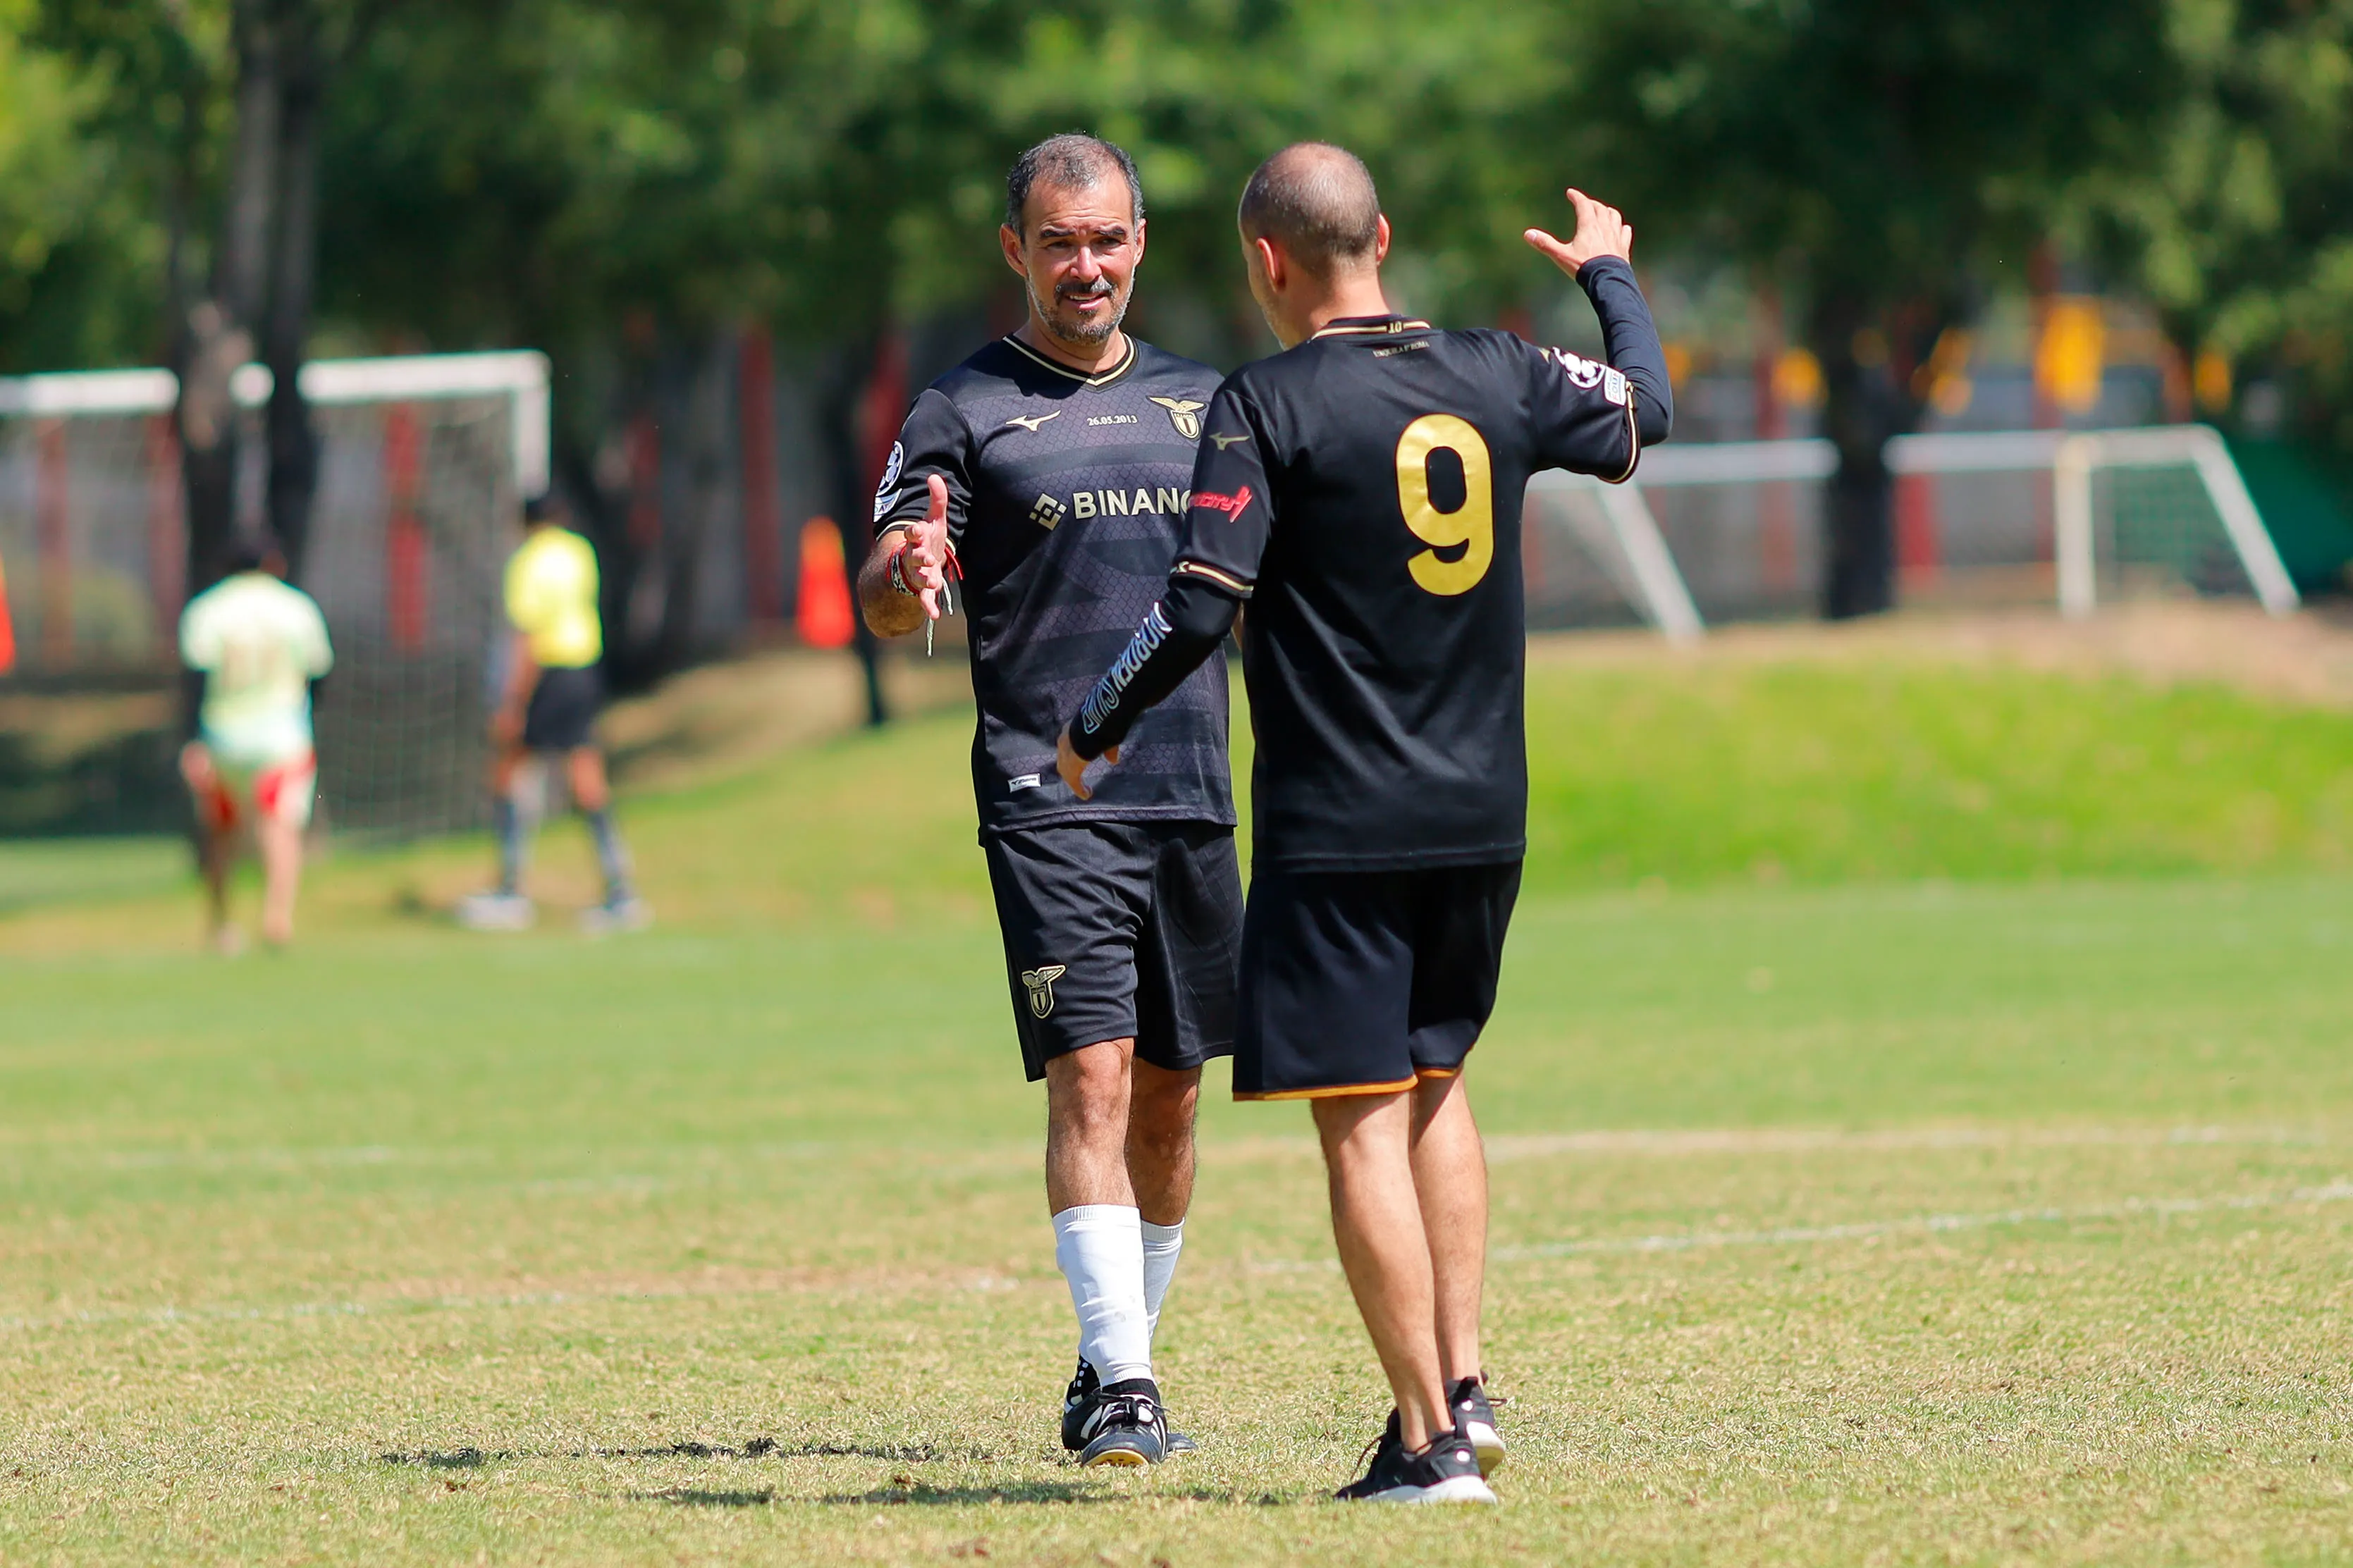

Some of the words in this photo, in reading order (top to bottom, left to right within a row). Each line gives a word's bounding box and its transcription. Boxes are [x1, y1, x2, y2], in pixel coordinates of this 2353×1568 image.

[1388, 321, 1402, 333] 10
[1086, 414, 1138, 426] 26.05.2013
[1396, 413, 1494, 596] 9
